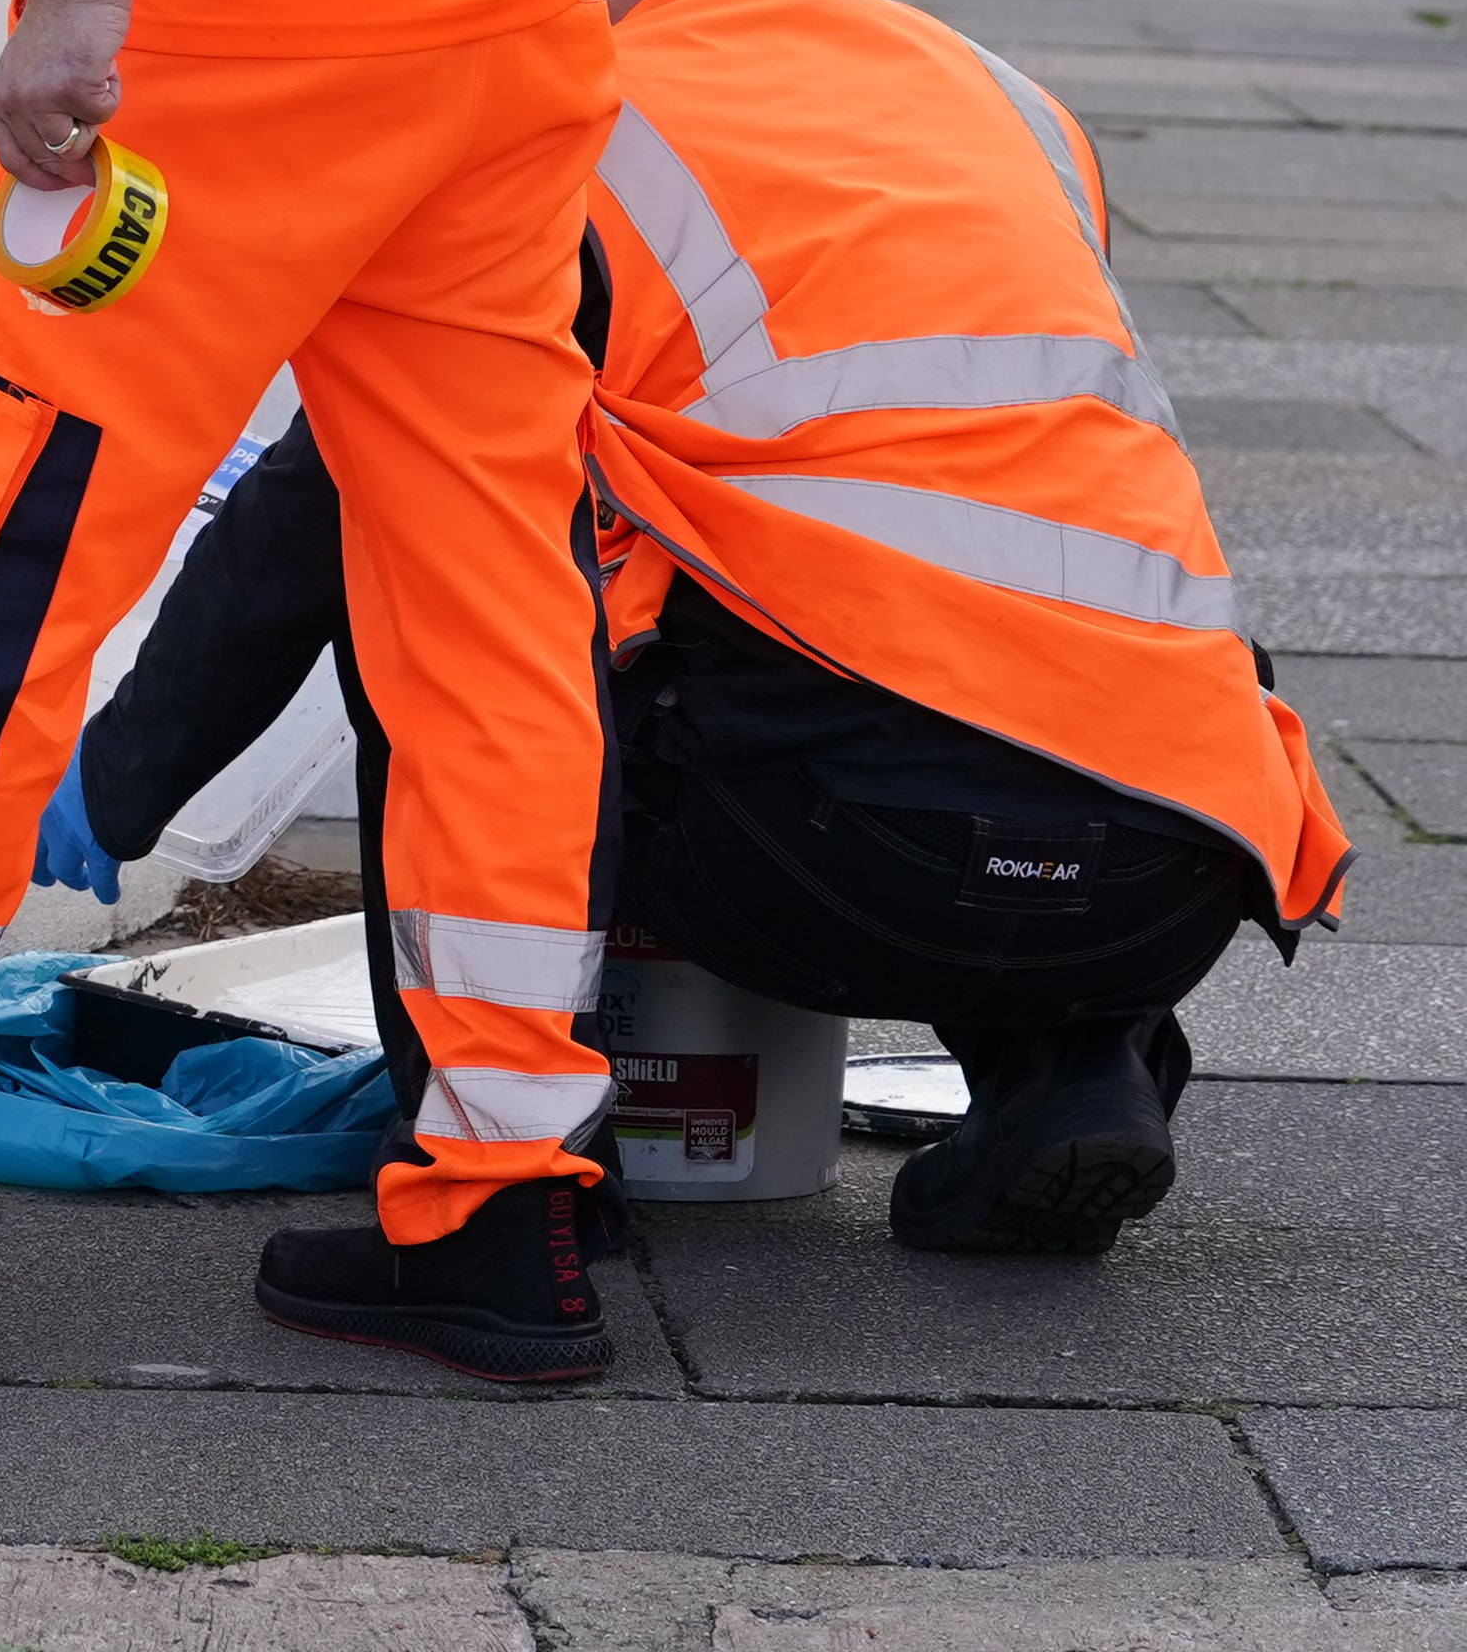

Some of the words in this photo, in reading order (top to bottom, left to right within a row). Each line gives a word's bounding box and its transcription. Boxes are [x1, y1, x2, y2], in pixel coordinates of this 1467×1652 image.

[40, 185, 158, 309] CAUTIO
[985, 856, 1081, 880] ROKWEAR
[690, 1126, 728, 1136] MOULD
